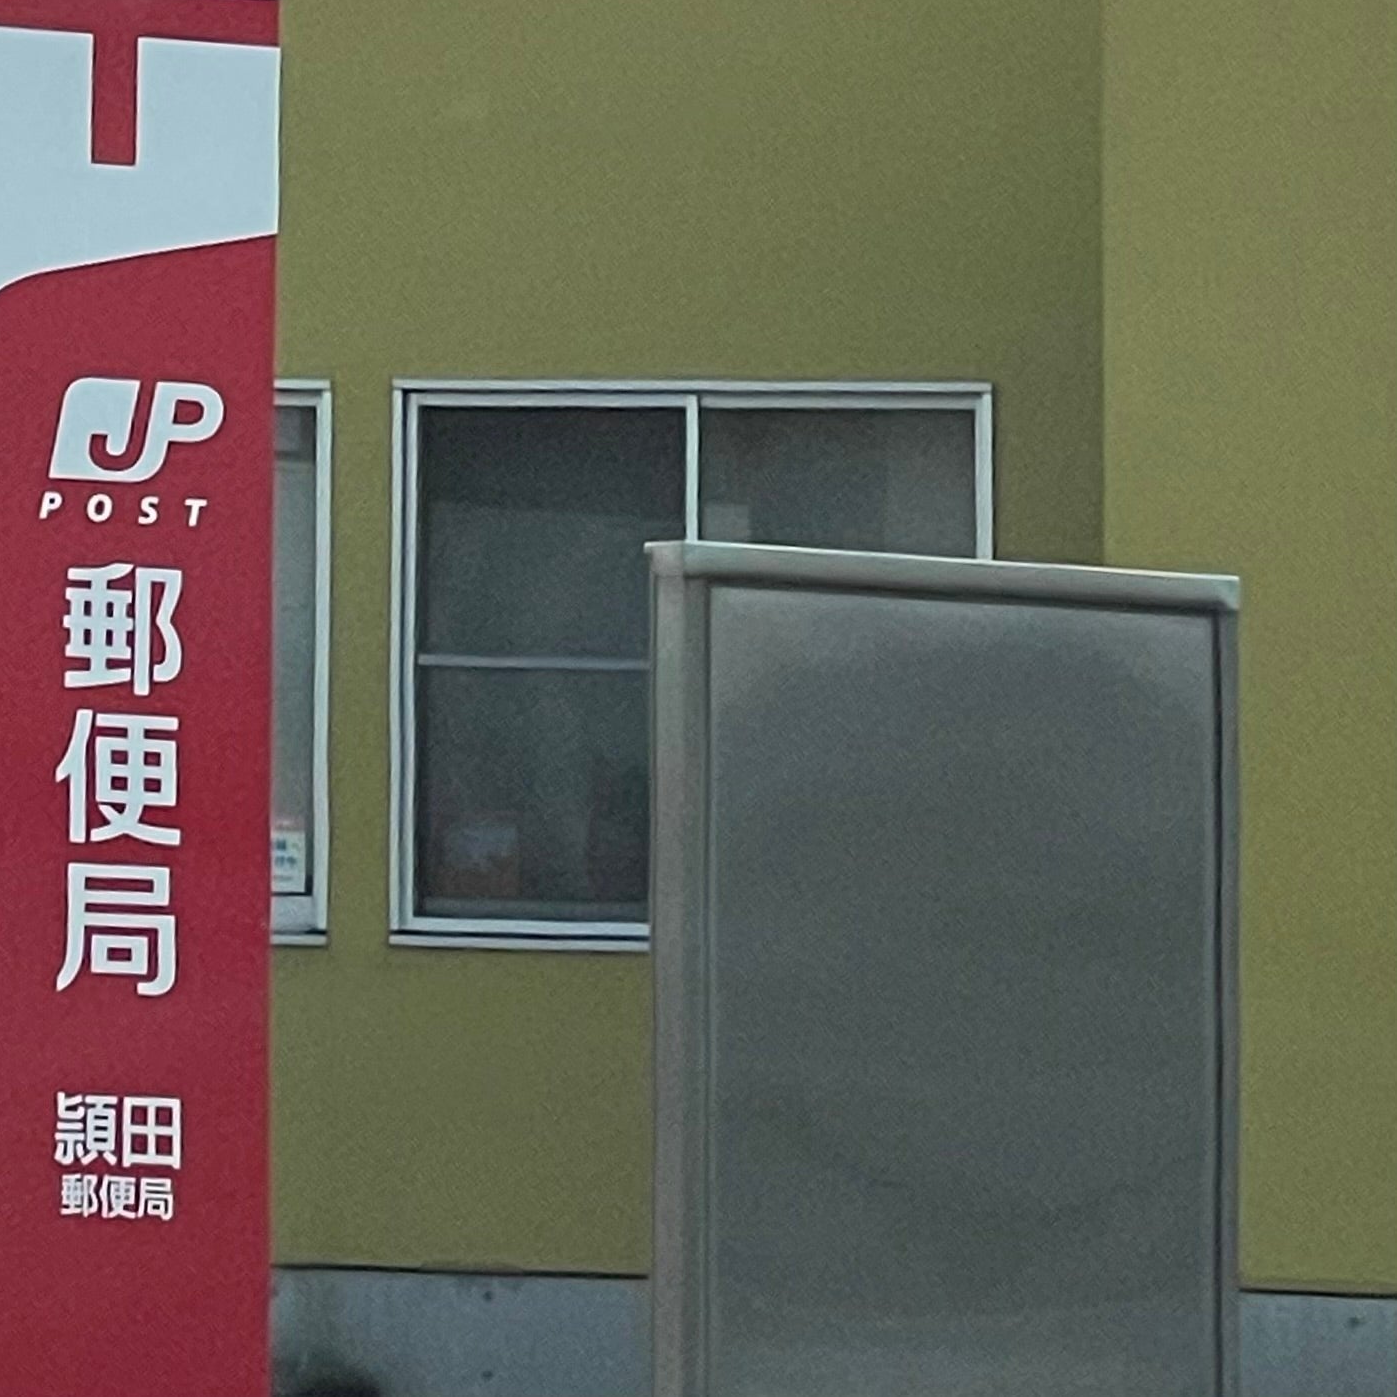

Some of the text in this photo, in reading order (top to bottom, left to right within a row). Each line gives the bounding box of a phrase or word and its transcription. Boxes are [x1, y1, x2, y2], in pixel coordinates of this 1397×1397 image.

[39, 491, 208, 527] POST
[55, 563, 183, 998] 郵便局
[60, 1174, 174, 1221] 郵便局
